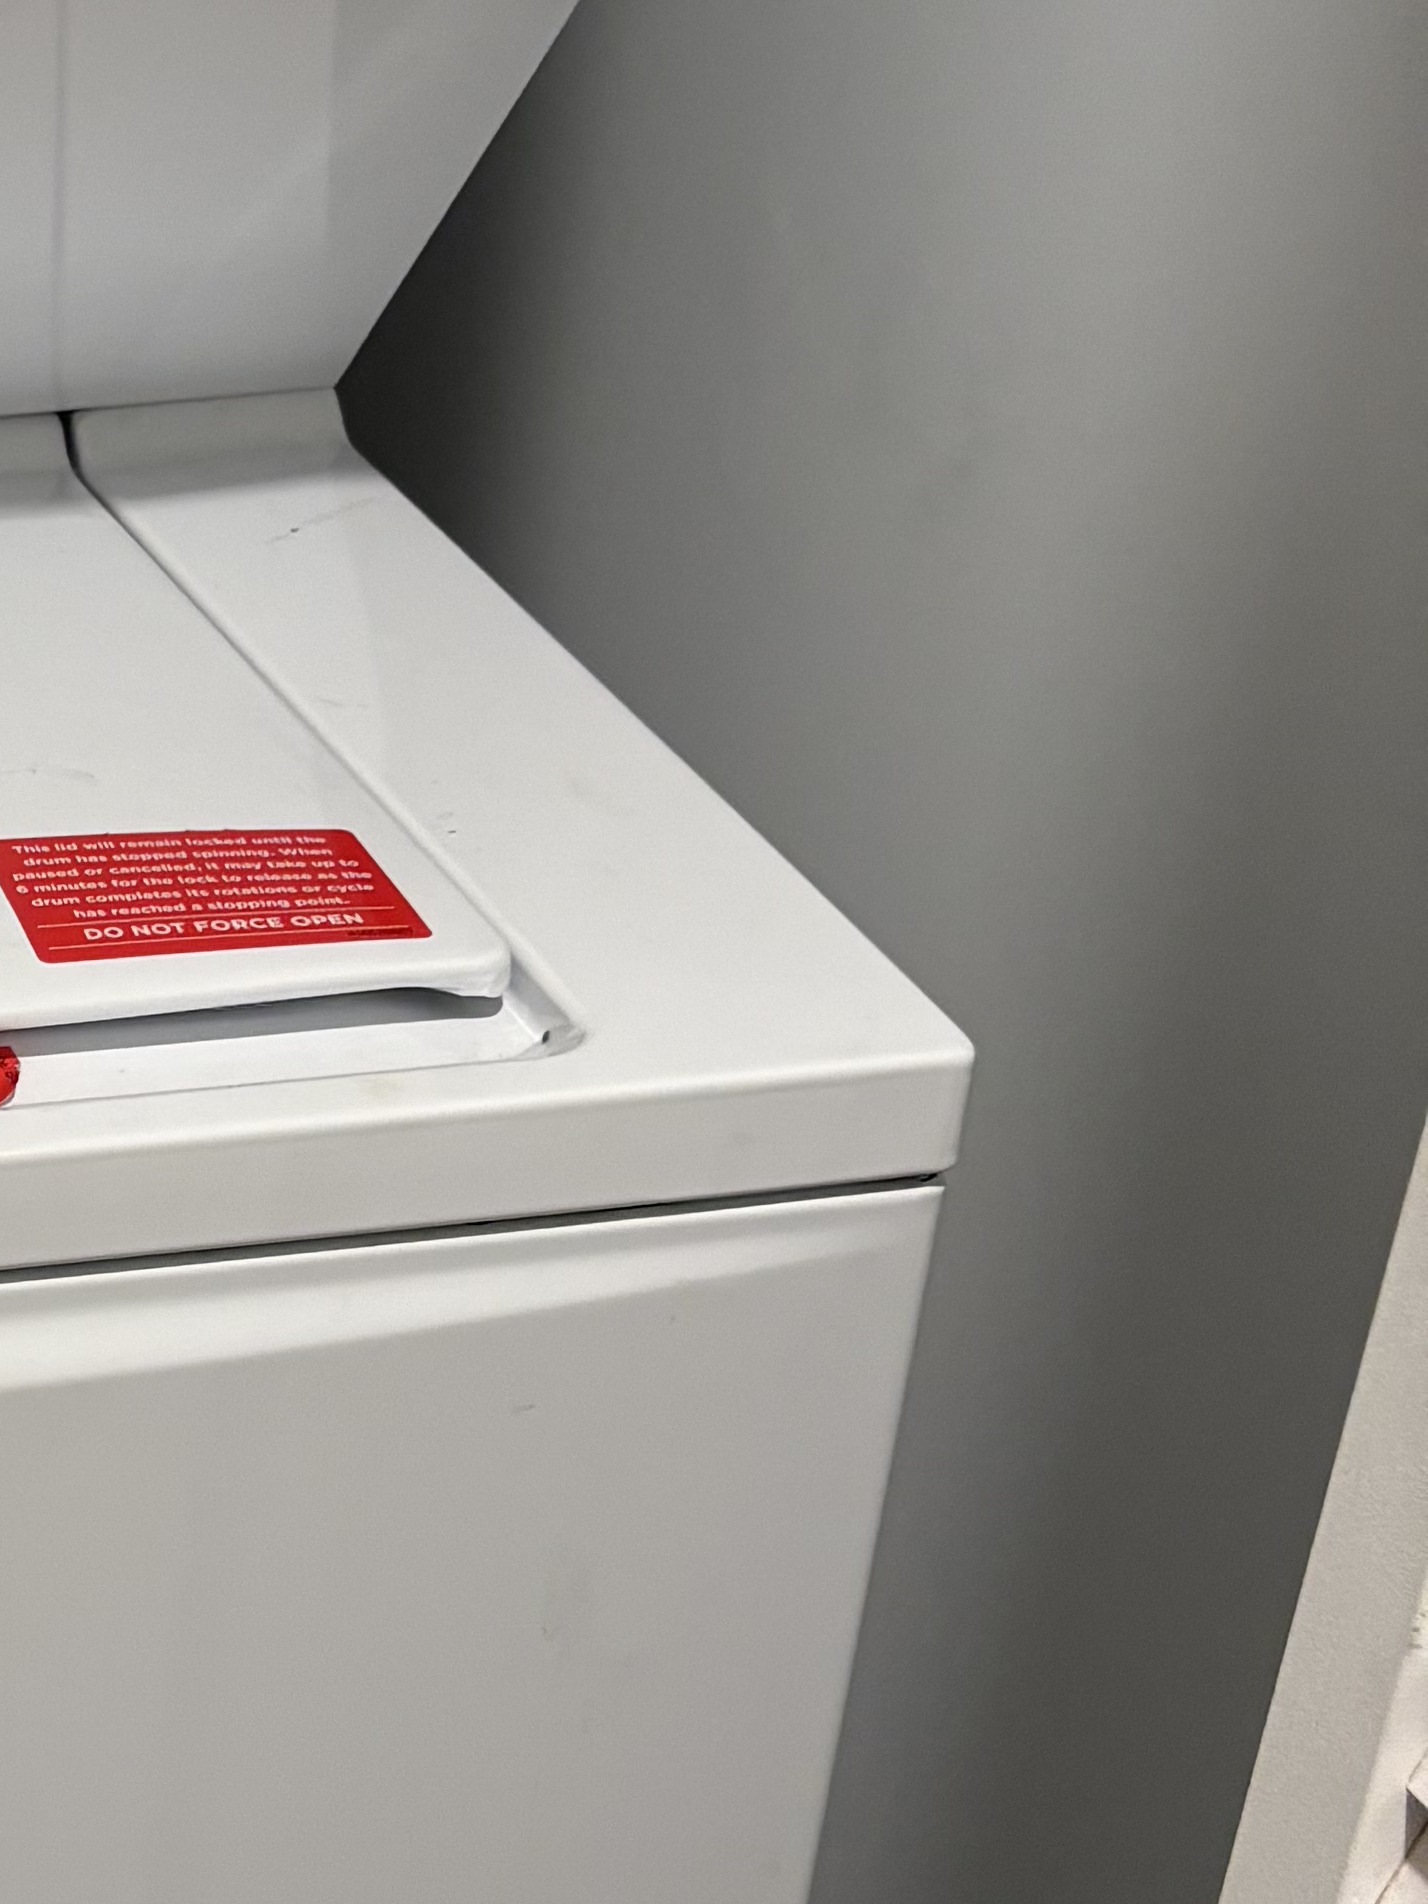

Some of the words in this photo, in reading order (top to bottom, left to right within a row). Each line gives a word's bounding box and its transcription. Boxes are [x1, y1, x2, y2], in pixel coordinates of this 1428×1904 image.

[12, 846, 50, 854] This
[55, 843, 78, 852] lid
[83, 841, 114, 850] will
[120, 839, 181, 848] remain
[186, 837, 246, 846] locked
[252, 836, 291, 844] until
[296, 836, 326, 844] the
[24, 858, 71, 867] drum
[76, 855, 107, 863] has
[113, 851, 187, 862] stopped
[193, 849, 275, 859] spinning.
[278, 848, 333, 856] When
[13, 869, 79, 881] paused
[225, 861, 261, 871] may
[267, 860, 306, 868] take
[34, 882, 107, 892] minutes
[111, 879, 137, 888] for
[143, 877, 173, 886] the
[247, 871, 312, 881] release
[341, 870, 372, 879] the
[32, 897, 80, 907] drum
[86, 891, 182, 903] completes
[214, 885, 297, 896] rotations
[327, 882, 374, 893] cycle
[73, 909, 107, 918] has
[111, 903, 186, 915] reached
[207, 899, 290, 910] stopping
[295, 897, 350, 907] point.
[84, 926, 123, 940] DO
[131, 923, 184, 937] NOT
[194, 916, 284, 932] FORCE
[291, 912, 364, 927] OPEN
